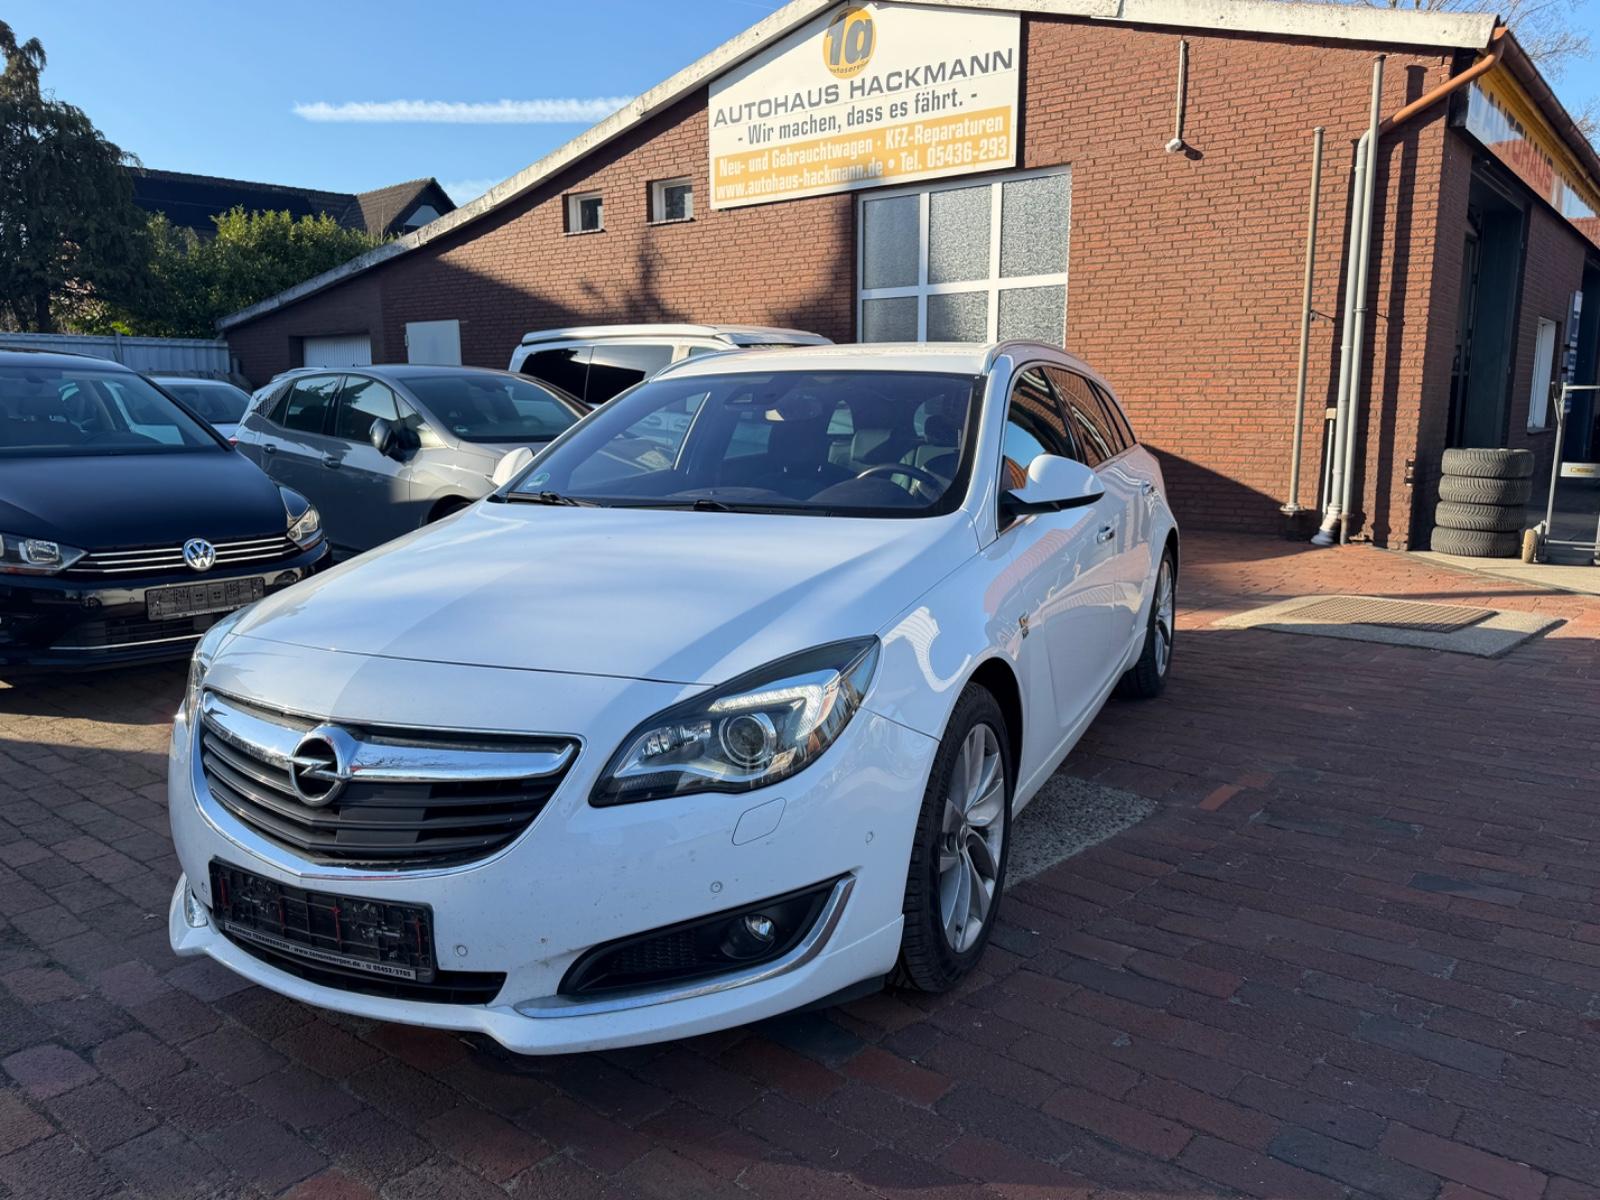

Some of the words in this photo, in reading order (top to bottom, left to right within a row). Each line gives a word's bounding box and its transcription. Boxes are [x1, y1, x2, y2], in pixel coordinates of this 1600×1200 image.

[713, 83, 840, 128] AUTOHAUS
[849, 47, 1013, 99] HACKMANN
[747, 122, 774, 145] Wir
[779, 113, 841, 140] machen,
[846, 105, 883, 127] dass
[889, 101, 908, 119] es
[914, 88, 963, 114] fährt.
[716, 157, 884, 200] www.autohaus-hackmann.de
[900, 151, 922, 173] Tel.
[927, 135, 1008, 168] 05436-293
[719, 158, 746, 177] Neu-
[748, 150, 769, 172] und
[771, 137, 873, 169] Gebrauchtwagen
[885, 115, 1004, 150] KFZ-Reparaturen
